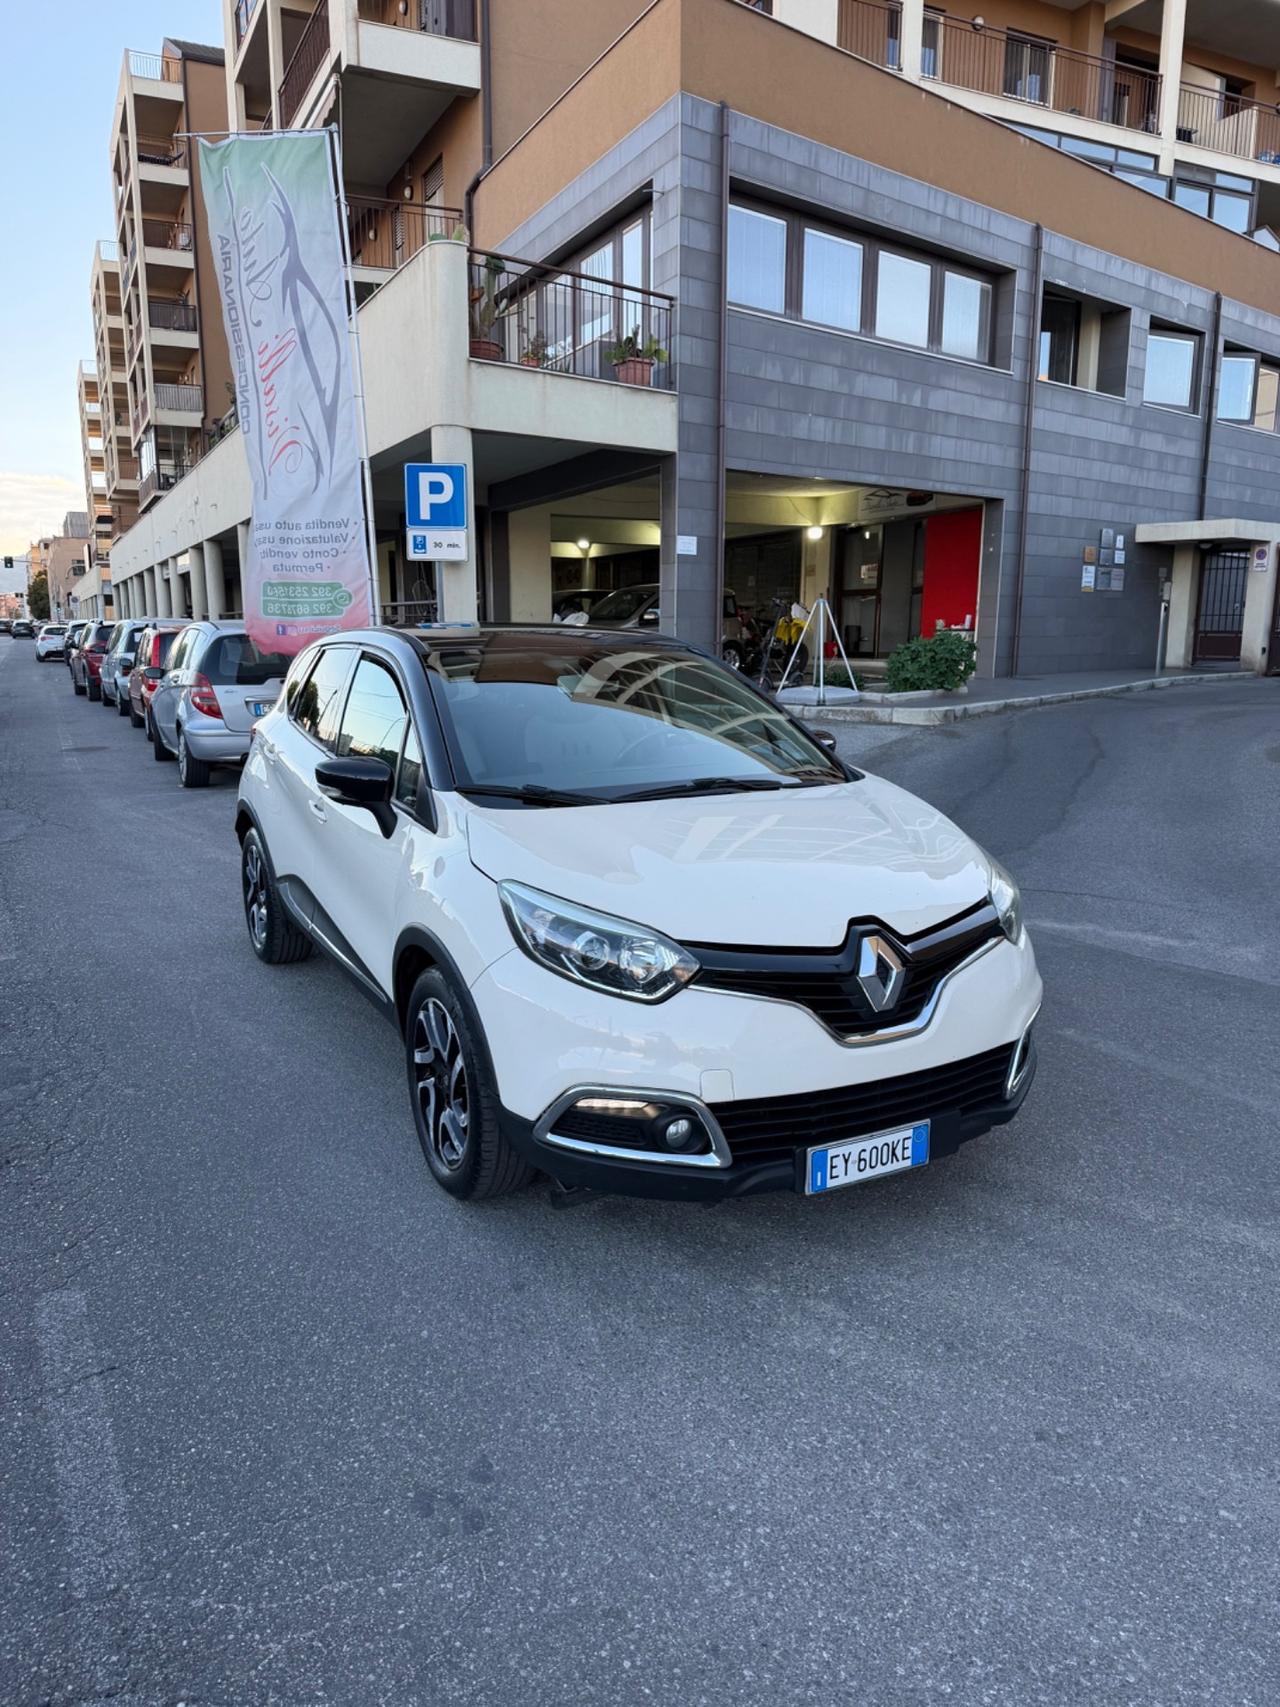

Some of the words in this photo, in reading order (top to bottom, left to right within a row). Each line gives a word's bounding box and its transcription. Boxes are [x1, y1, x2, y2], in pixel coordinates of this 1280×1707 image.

[418, 471, 454, 520] P
[829, 1151, 852, 1180] EY
[857, 1136, 912, 1173] 600KE
